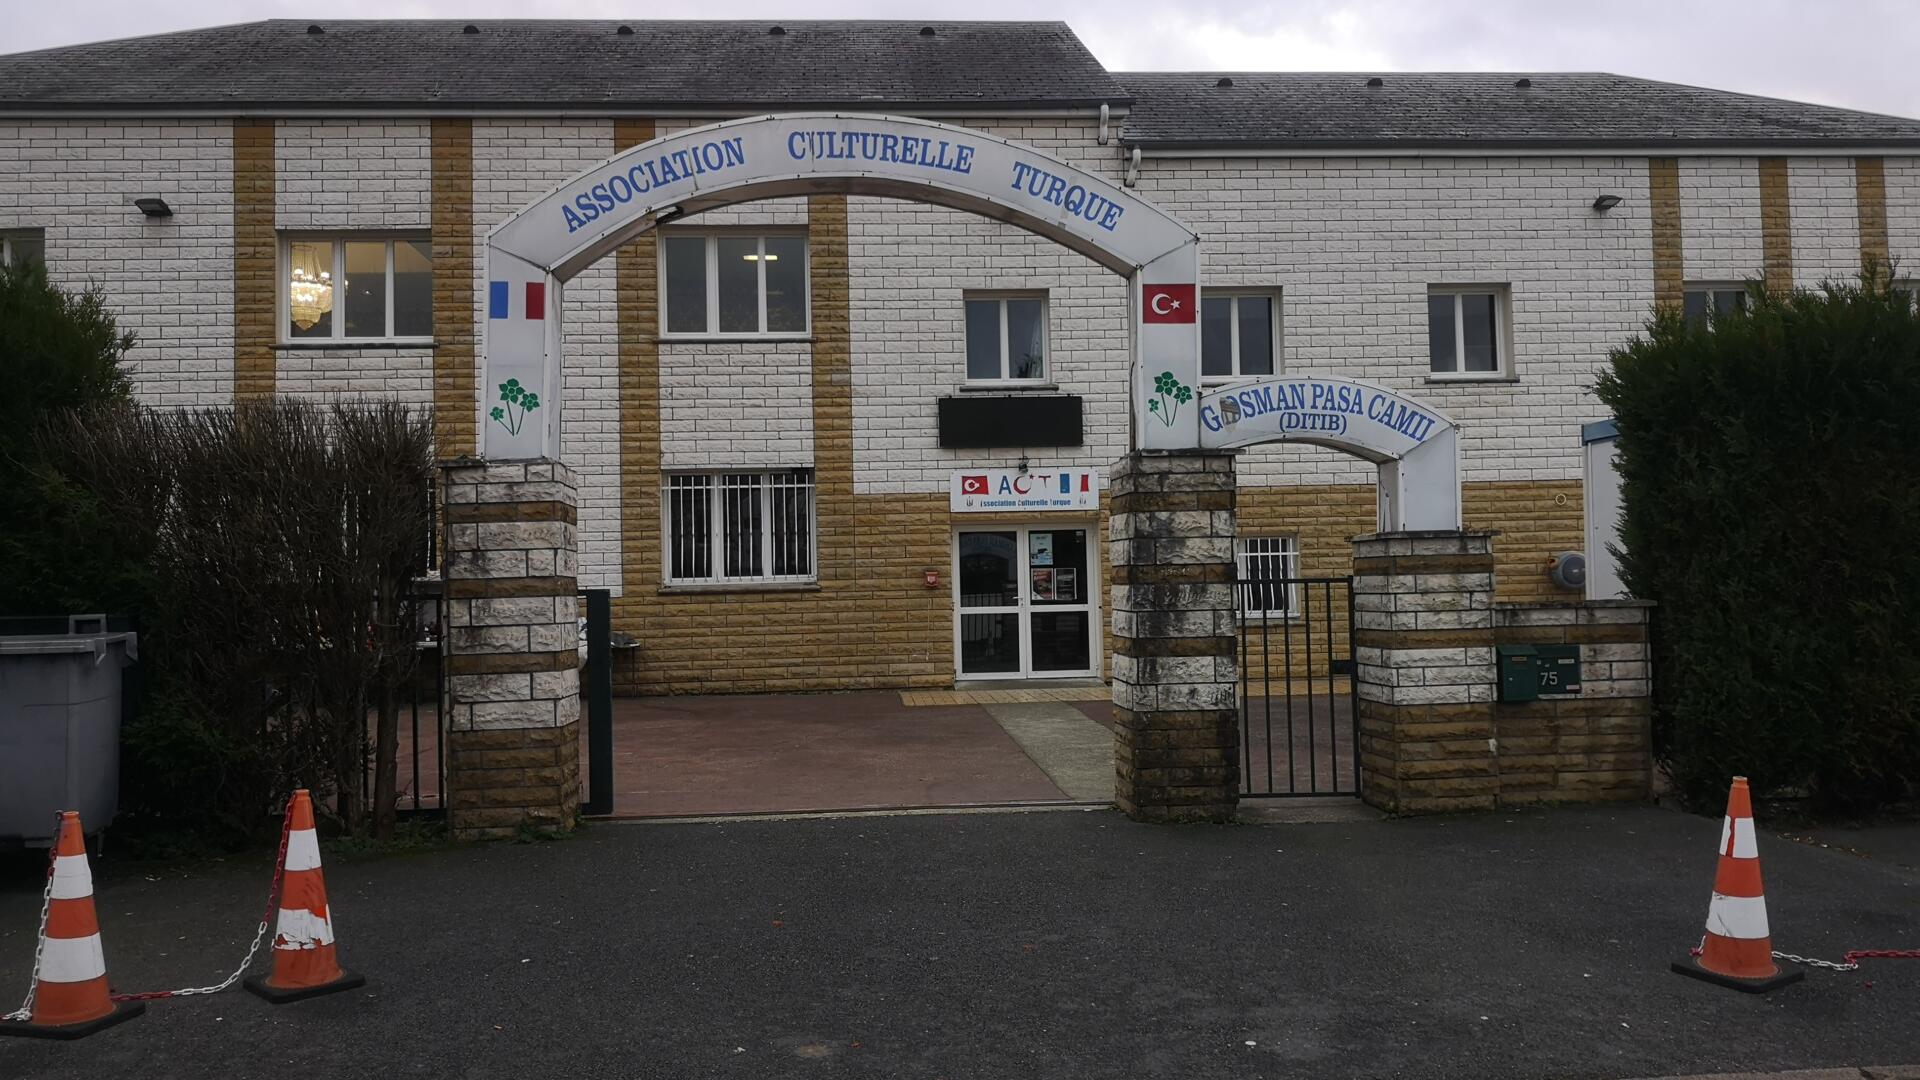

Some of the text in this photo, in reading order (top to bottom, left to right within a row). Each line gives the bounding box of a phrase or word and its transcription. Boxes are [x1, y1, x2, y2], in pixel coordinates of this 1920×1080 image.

[561, 131, 1125, 233] ASSOCIATION CULTURELLE TURQUE
[1310, 383, 1364, 415] PASA
[1279, 411, 1348, 436] (DITIB)
[1540, 671, 1558, 686] 75
